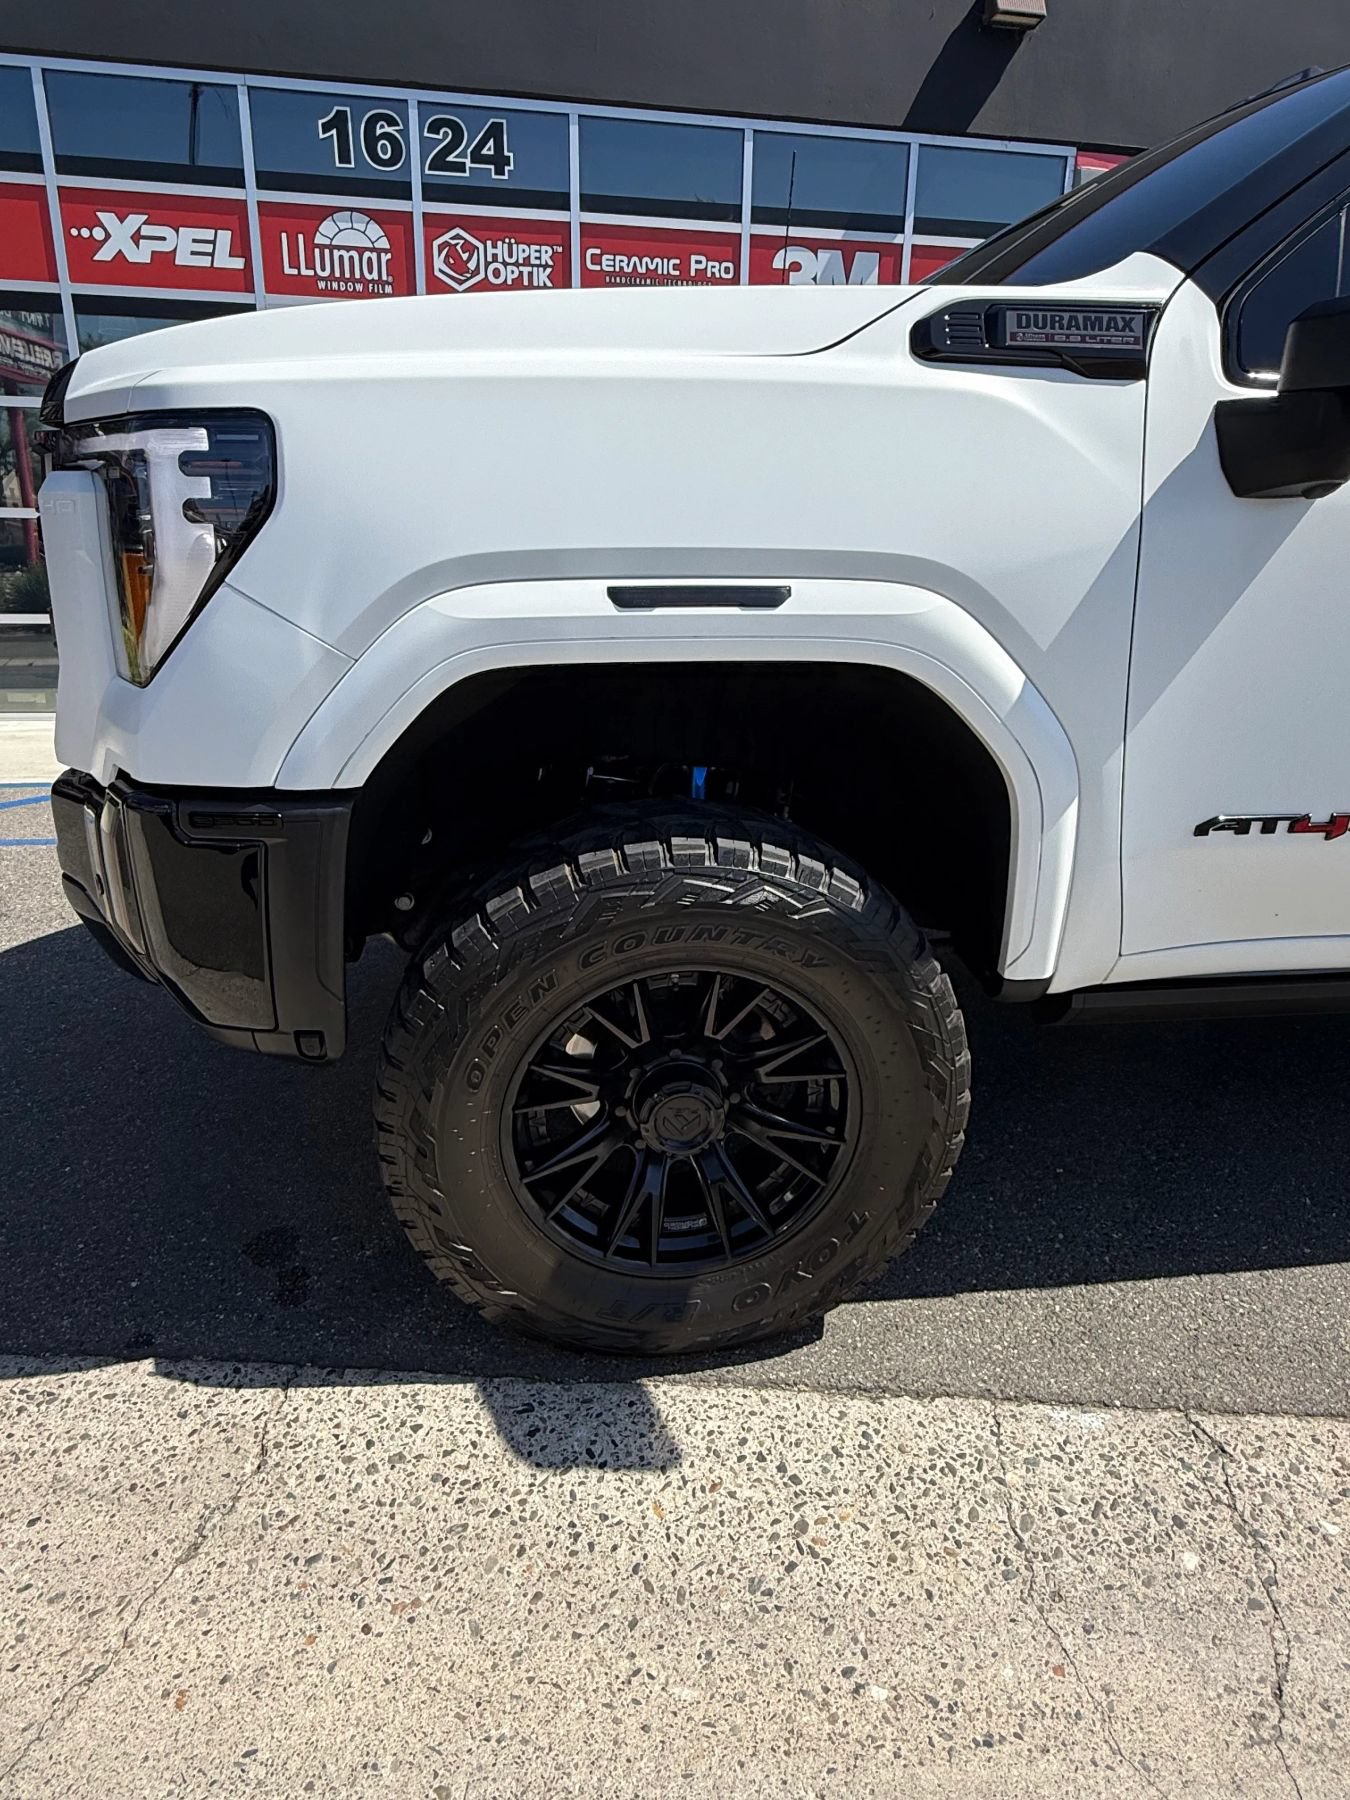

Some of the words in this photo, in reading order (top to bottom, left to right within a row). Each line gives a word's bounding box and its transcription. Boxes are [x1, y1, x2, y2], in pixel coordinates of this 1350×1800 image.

[93, 211, 246, 269] XPEL
[487, 262, 553, 288] OPTIK
[772, 245, 880, 286] 3M
[317, 280, 364, 293] WINDOW
[368, 283, 394, 295] FILM
[1016, 312, 1136, 334] DURAMAX
[465, 969, 559, 1093] OPEN
[577, 923, 831, 970] COUNTRY
[731, 1210, 872, 1313] TOYO
